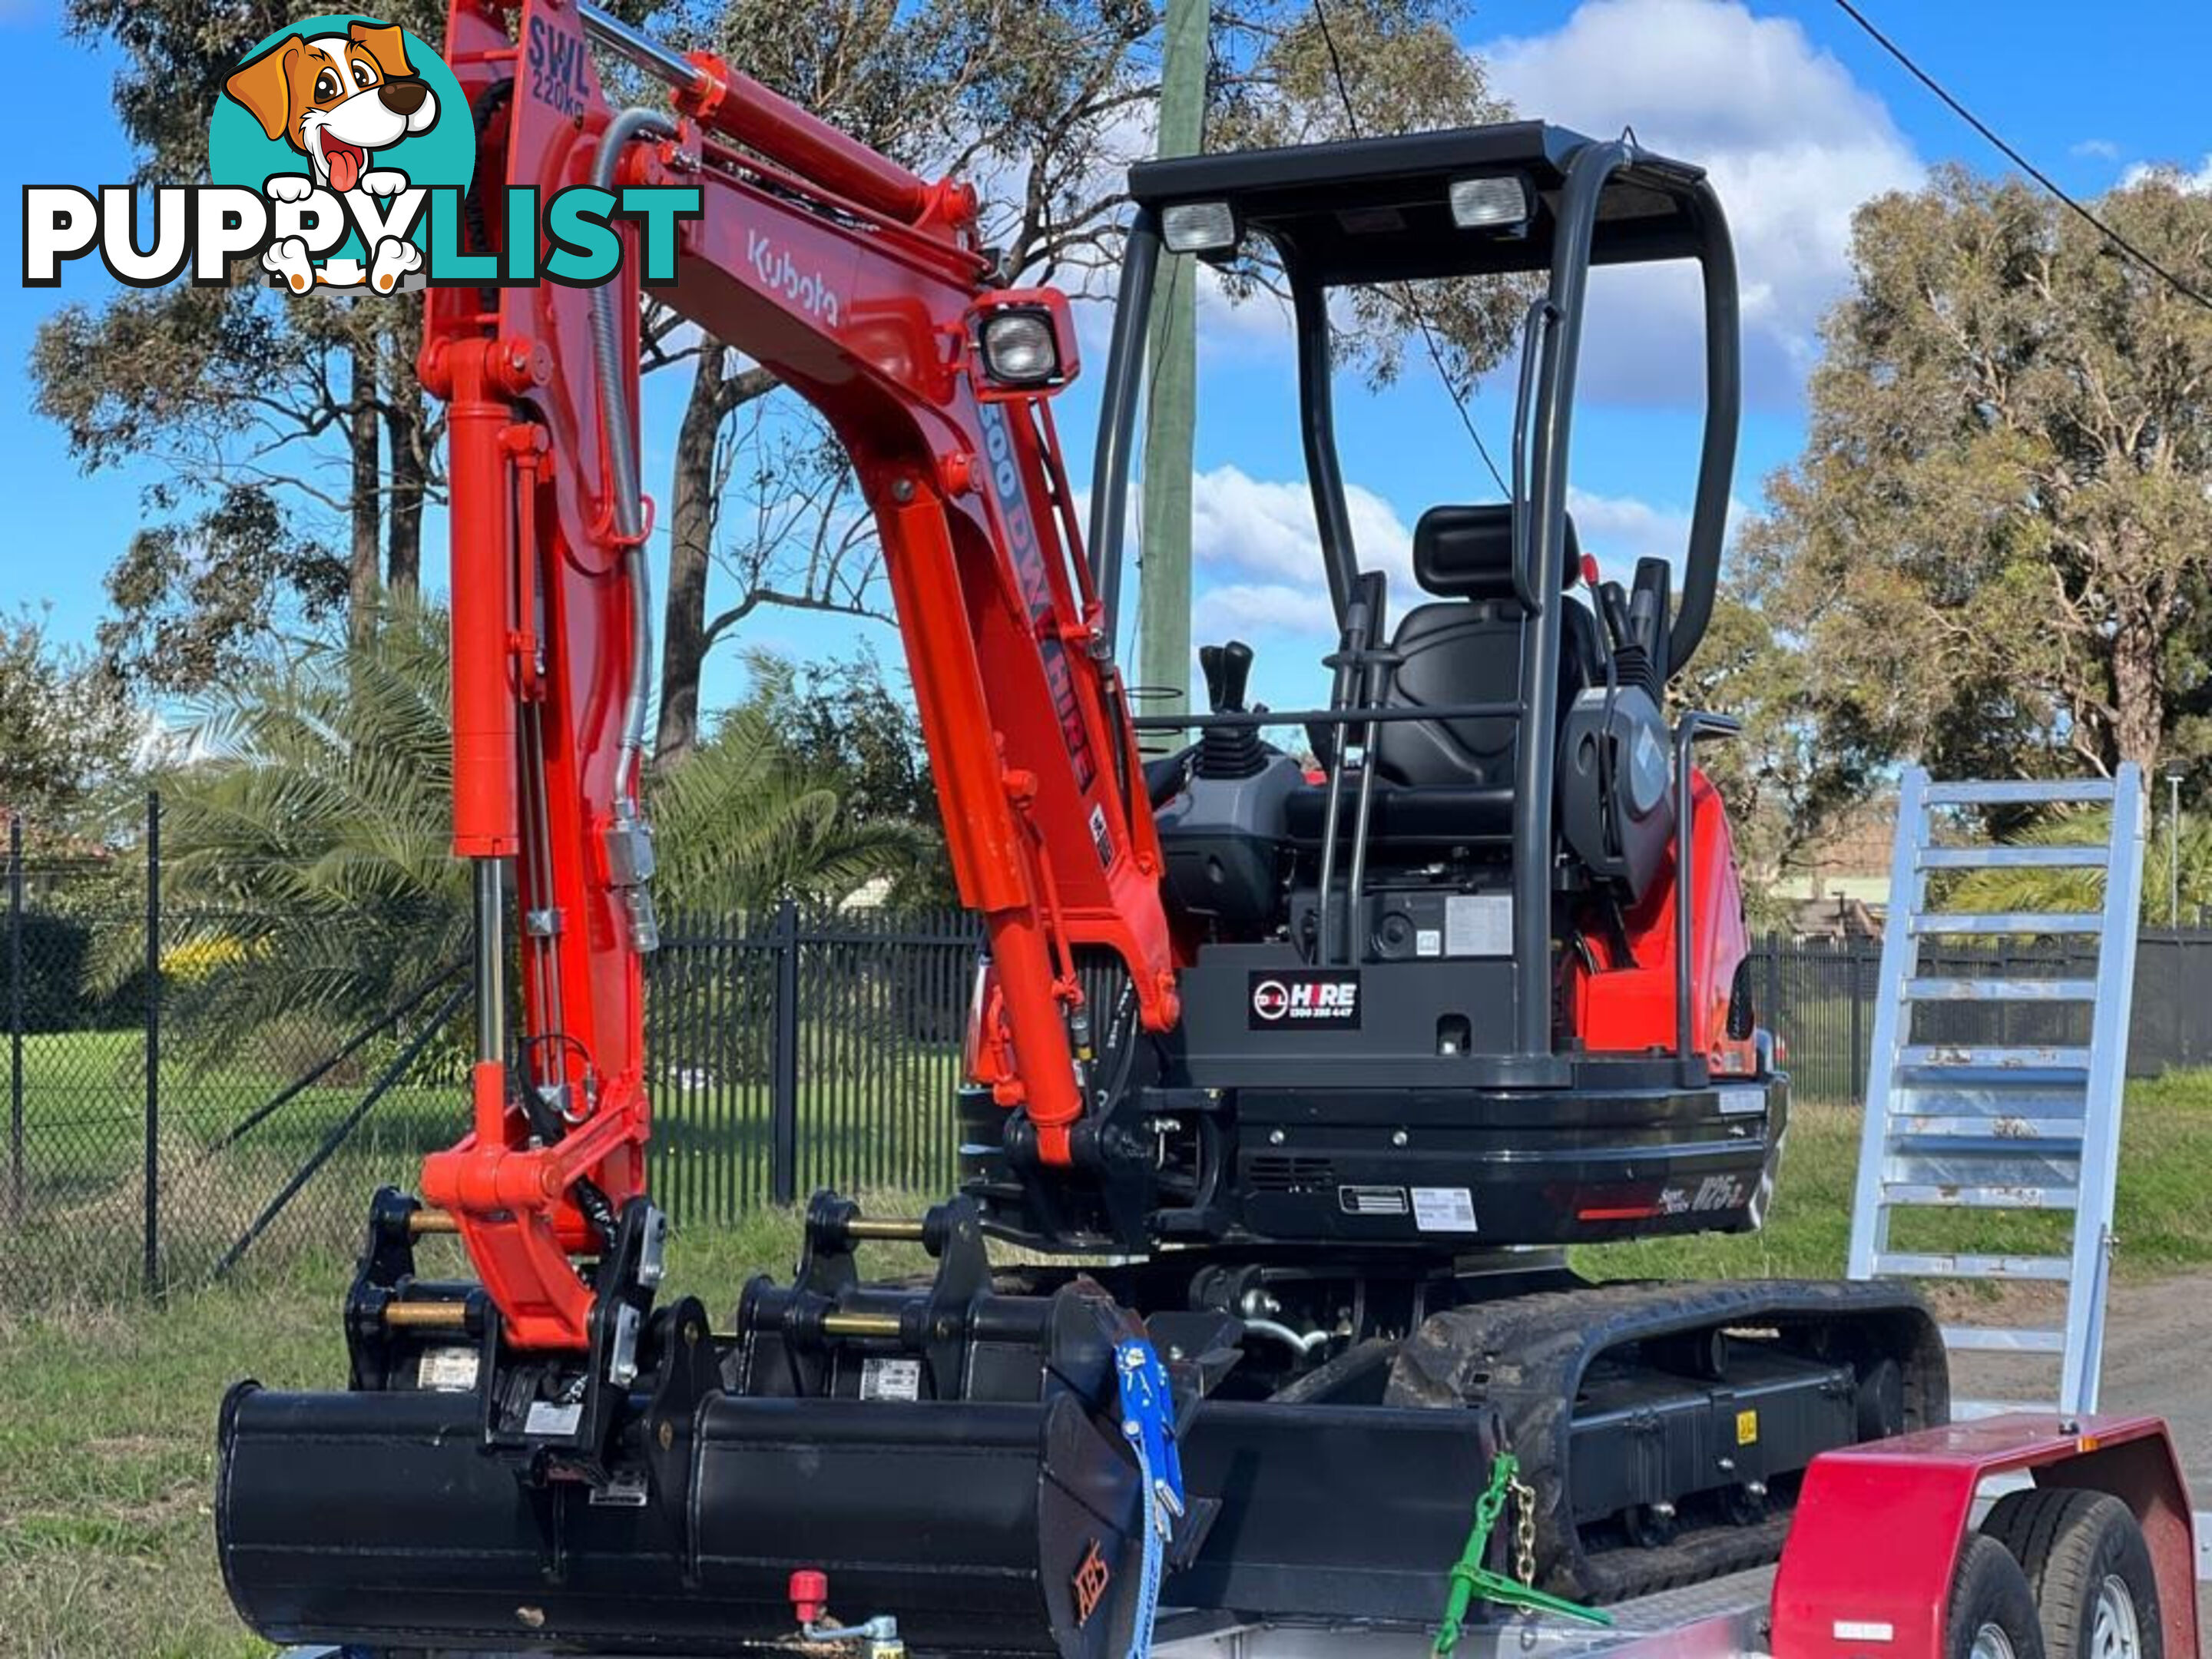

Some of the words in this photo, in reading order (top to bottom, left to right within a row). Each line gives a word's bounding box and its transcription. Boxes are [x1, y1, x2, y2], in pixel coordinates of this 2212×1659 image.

[528, 15, 590, 98] SWL
[747, 229, 838, 328] Kubota
[1290, 983, 1357, 1006] HIRE
